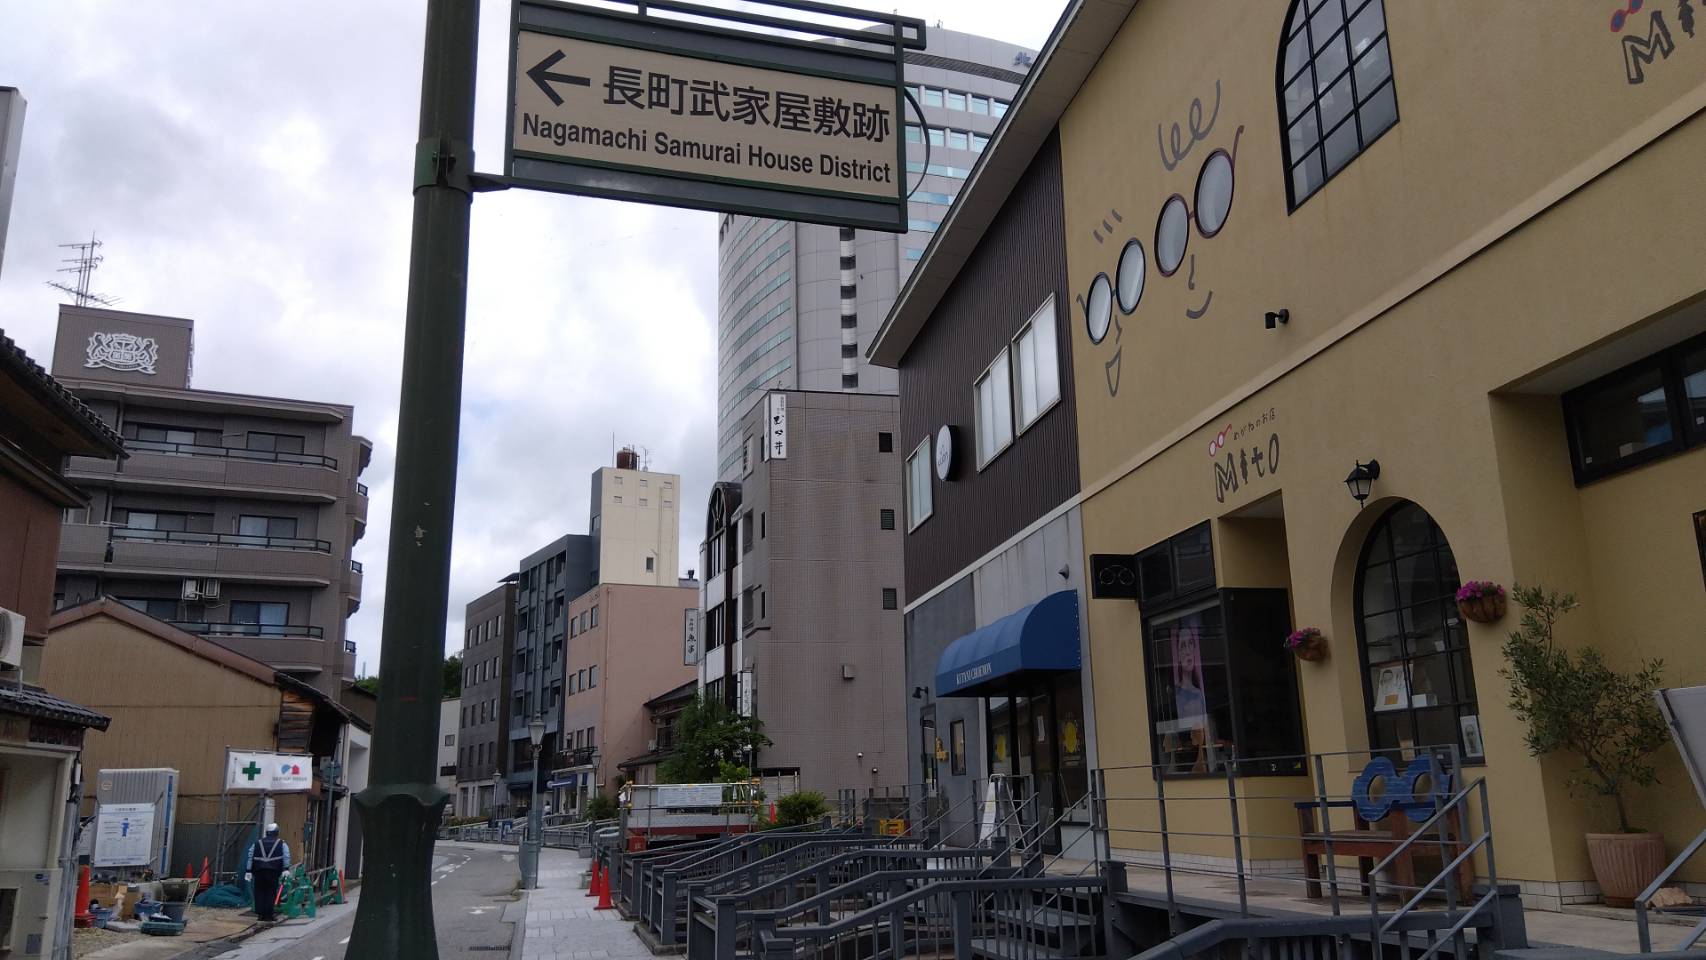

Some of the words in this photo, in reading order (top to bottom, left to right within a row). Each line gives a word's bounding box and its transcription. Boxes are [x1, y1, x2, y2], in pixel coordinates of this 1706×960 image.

[603, 65, 890, 143] 長町武家屋敷跡
[522, 112, 647, 153] Nagamachi
[654, 132, 741, 165] Samurai
[748, 143, 813, 173] House
[820, 154, 891, 184] District
